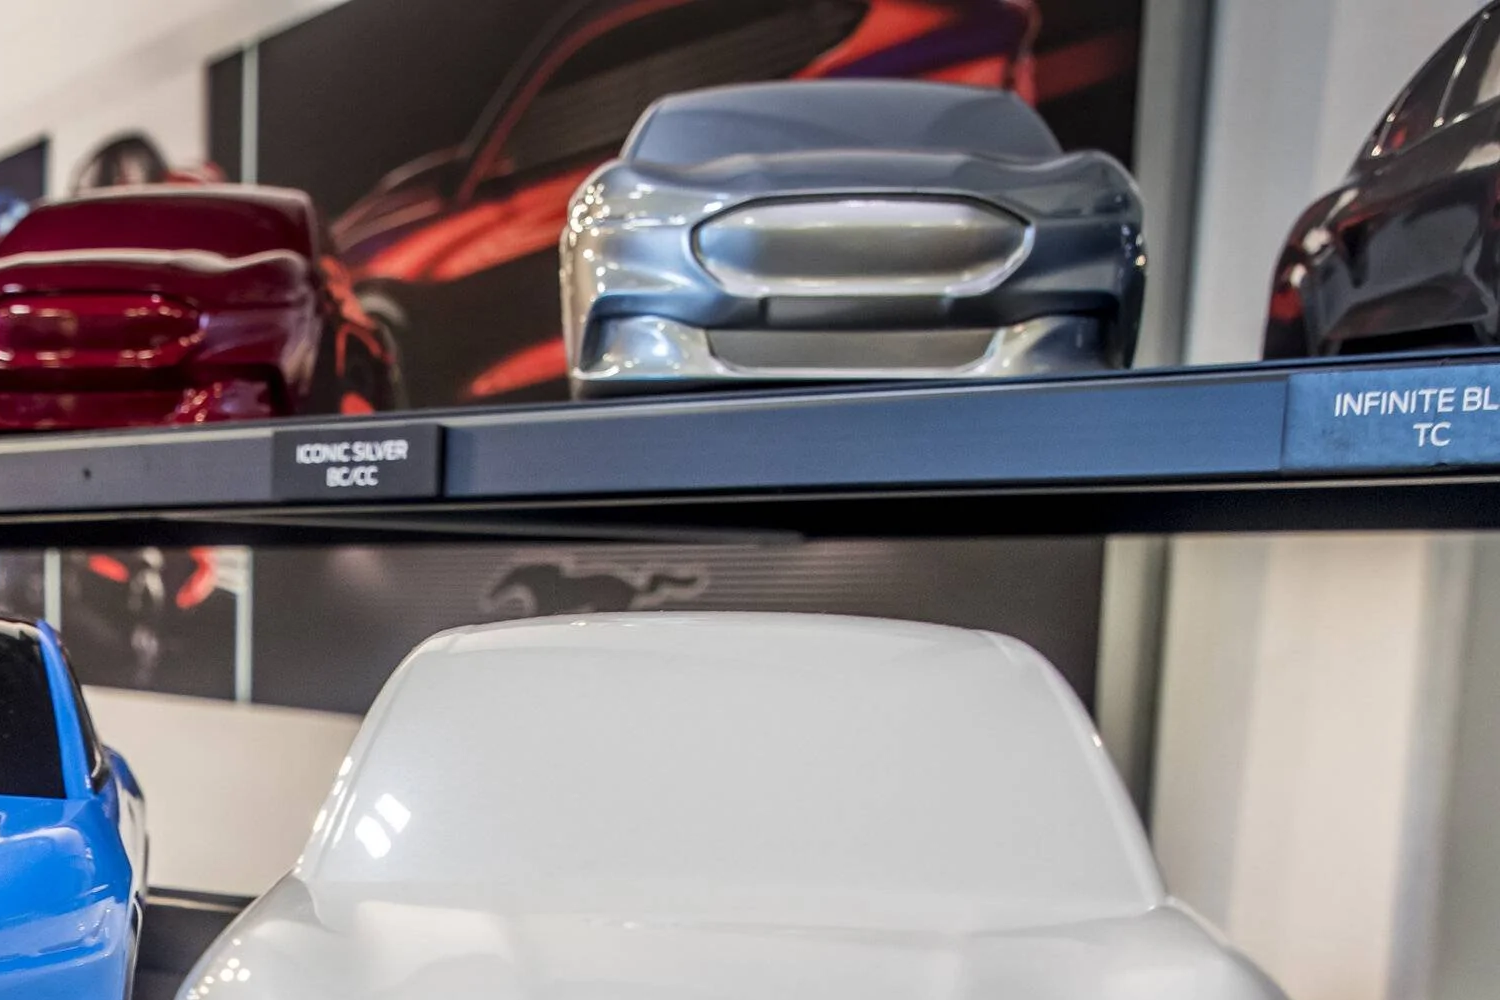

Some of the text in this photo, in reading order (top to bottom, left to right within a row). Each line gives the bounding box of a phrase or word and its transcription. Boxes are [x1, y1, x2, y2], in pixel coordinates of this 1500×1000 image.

[1334, 387, 1457, 417] INFINITE
[1413, 421, 1452, 447] TC
[296, 439, 409, 464] ICONIC SILVER
